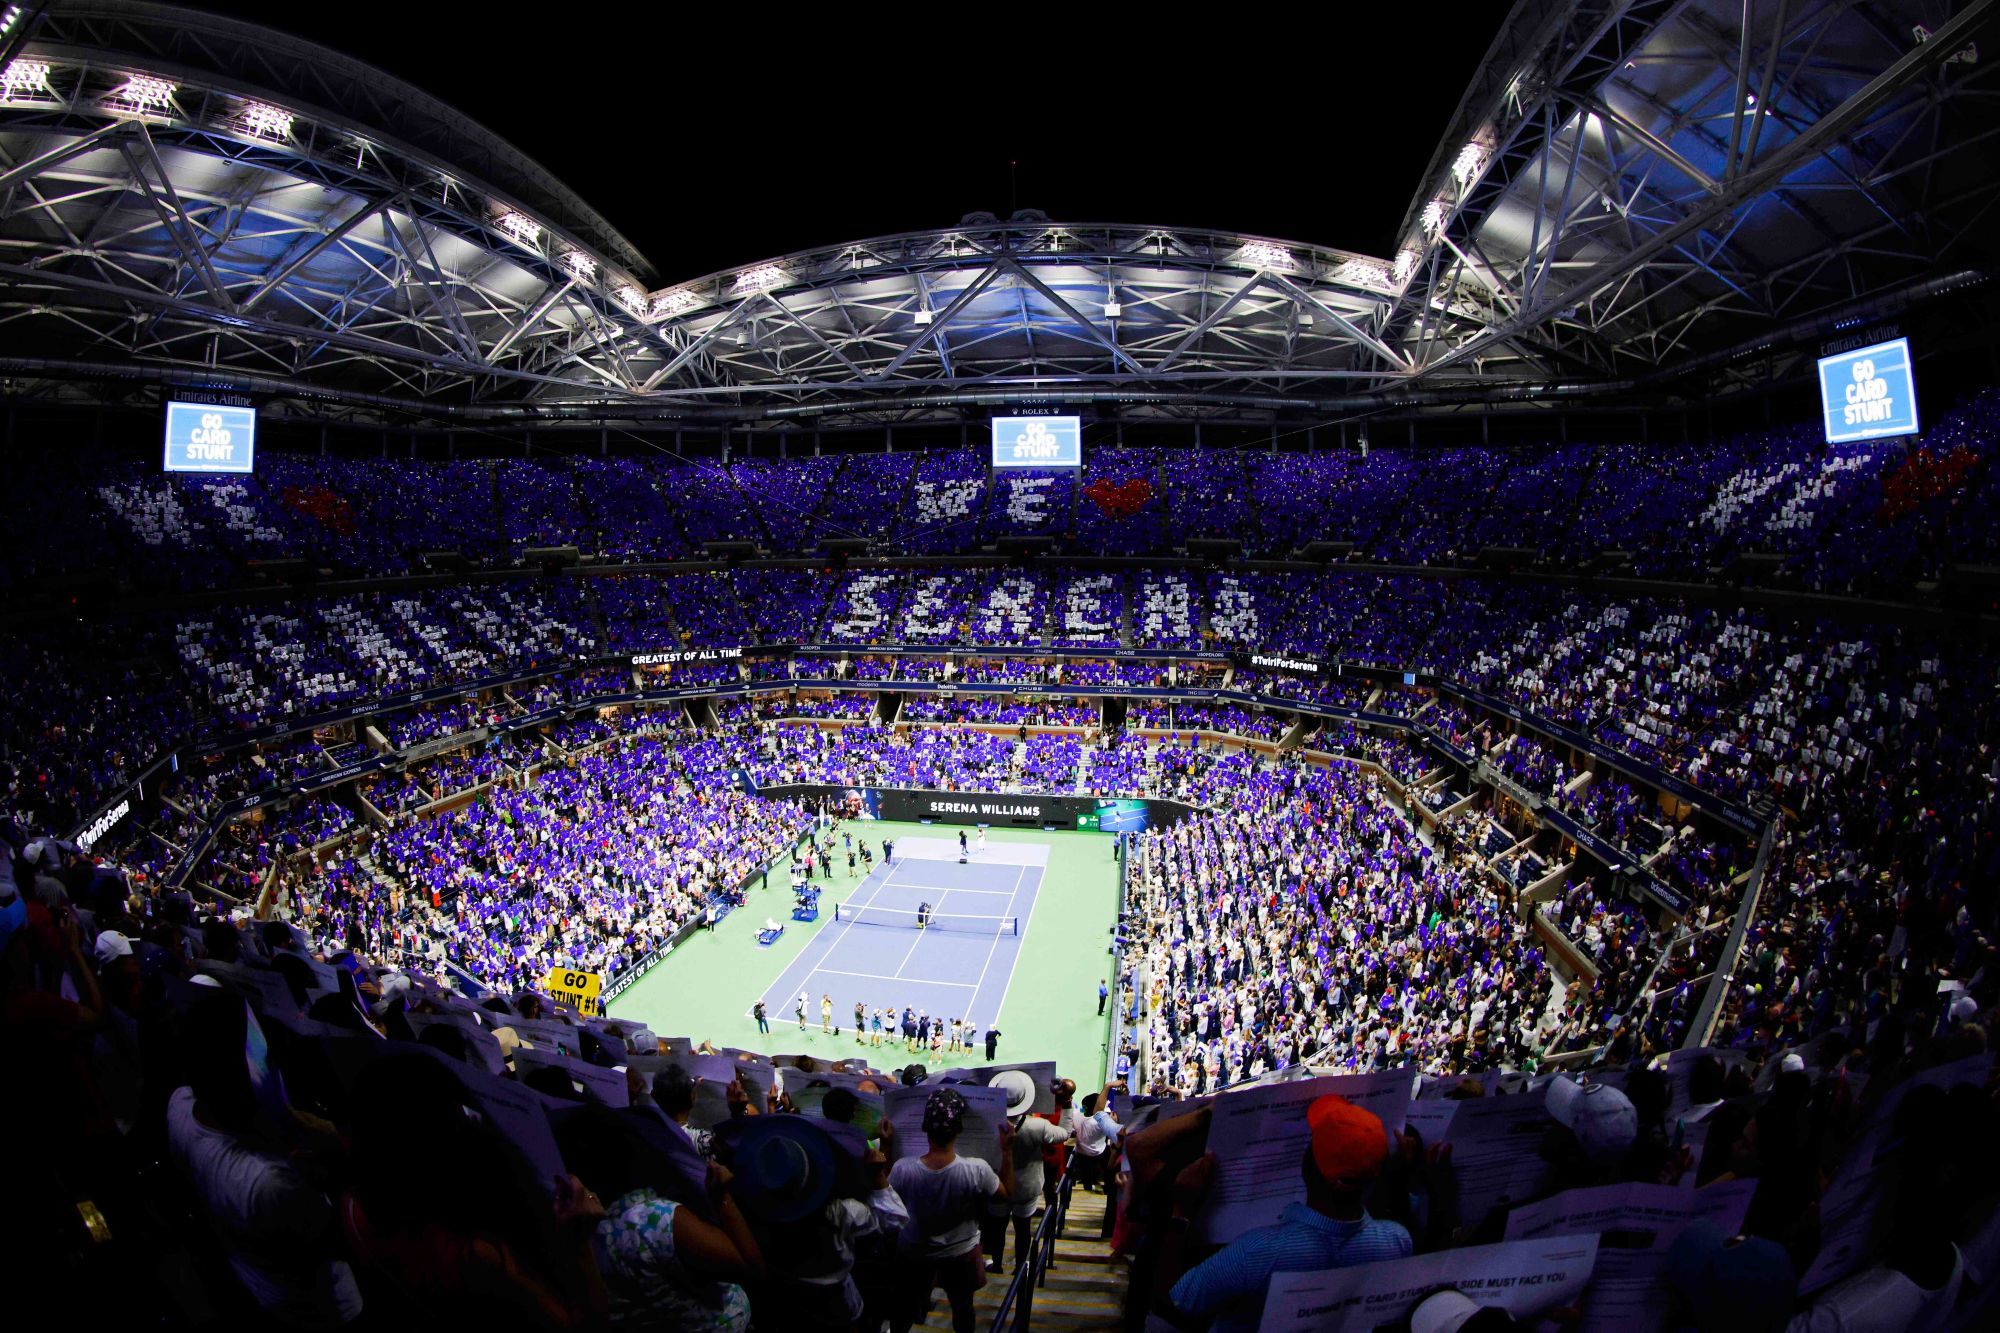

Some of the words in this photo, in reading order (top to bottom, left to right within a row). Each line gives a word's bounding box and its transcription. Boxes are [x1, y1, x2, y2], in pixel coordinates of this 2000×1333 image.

[1821, 337, 1863, 356] Emirates
[1864, 325, 1900, 345] Airline
[1852, 359, 1875, 382] GO
[174, 389, 216, 403] Emirates
[219, 394, 252, 407] Airline
[1845, 378, 1888, 404] CARD
[1844, 398, 1893, 425] STUNT
[201, 413, 223, 429] GO
[1026, 423, 1047, 434] GO
[191, 428, 231, 445] CARD
[1017, 434, 1056, 446] CARD
[186, 443, 234, 460] STUNT
[1013, 445, 1060, 458] STUNT
[632, 653, 681, 665] GREATEST
[684, 651, 696, 661] OF
[699, 650, 717, 660] ALL
[720, 648, 742, 658] TIME
[1252, 656, 1318, 672] #TwirlForSerena
[243, 796, 261, 809] ATP
[930, 801, 978, 814] SERENA
[981, 804, 1040, 817] WILLIAMS
[1576, 829, 1595, 848] CHASE
[564, 972, 587, 989] GO
[603, 971, 635, 1003] REATEST
[636, 964, 645, 978] OF
[646, 955, 660, 970] ALL
[659, 941, 674, 959] TIME
[551, 989, 582, 1012] STUNT
[584, 996, 596, 1013] #1
[1366, 1291, 1397, 1305] CARD
[1462, 1278, 1485, 1290] SIDE
[1487, 1276, 1517, 1288] MUST
[1519, 1274, 1544, 1286] FACE
